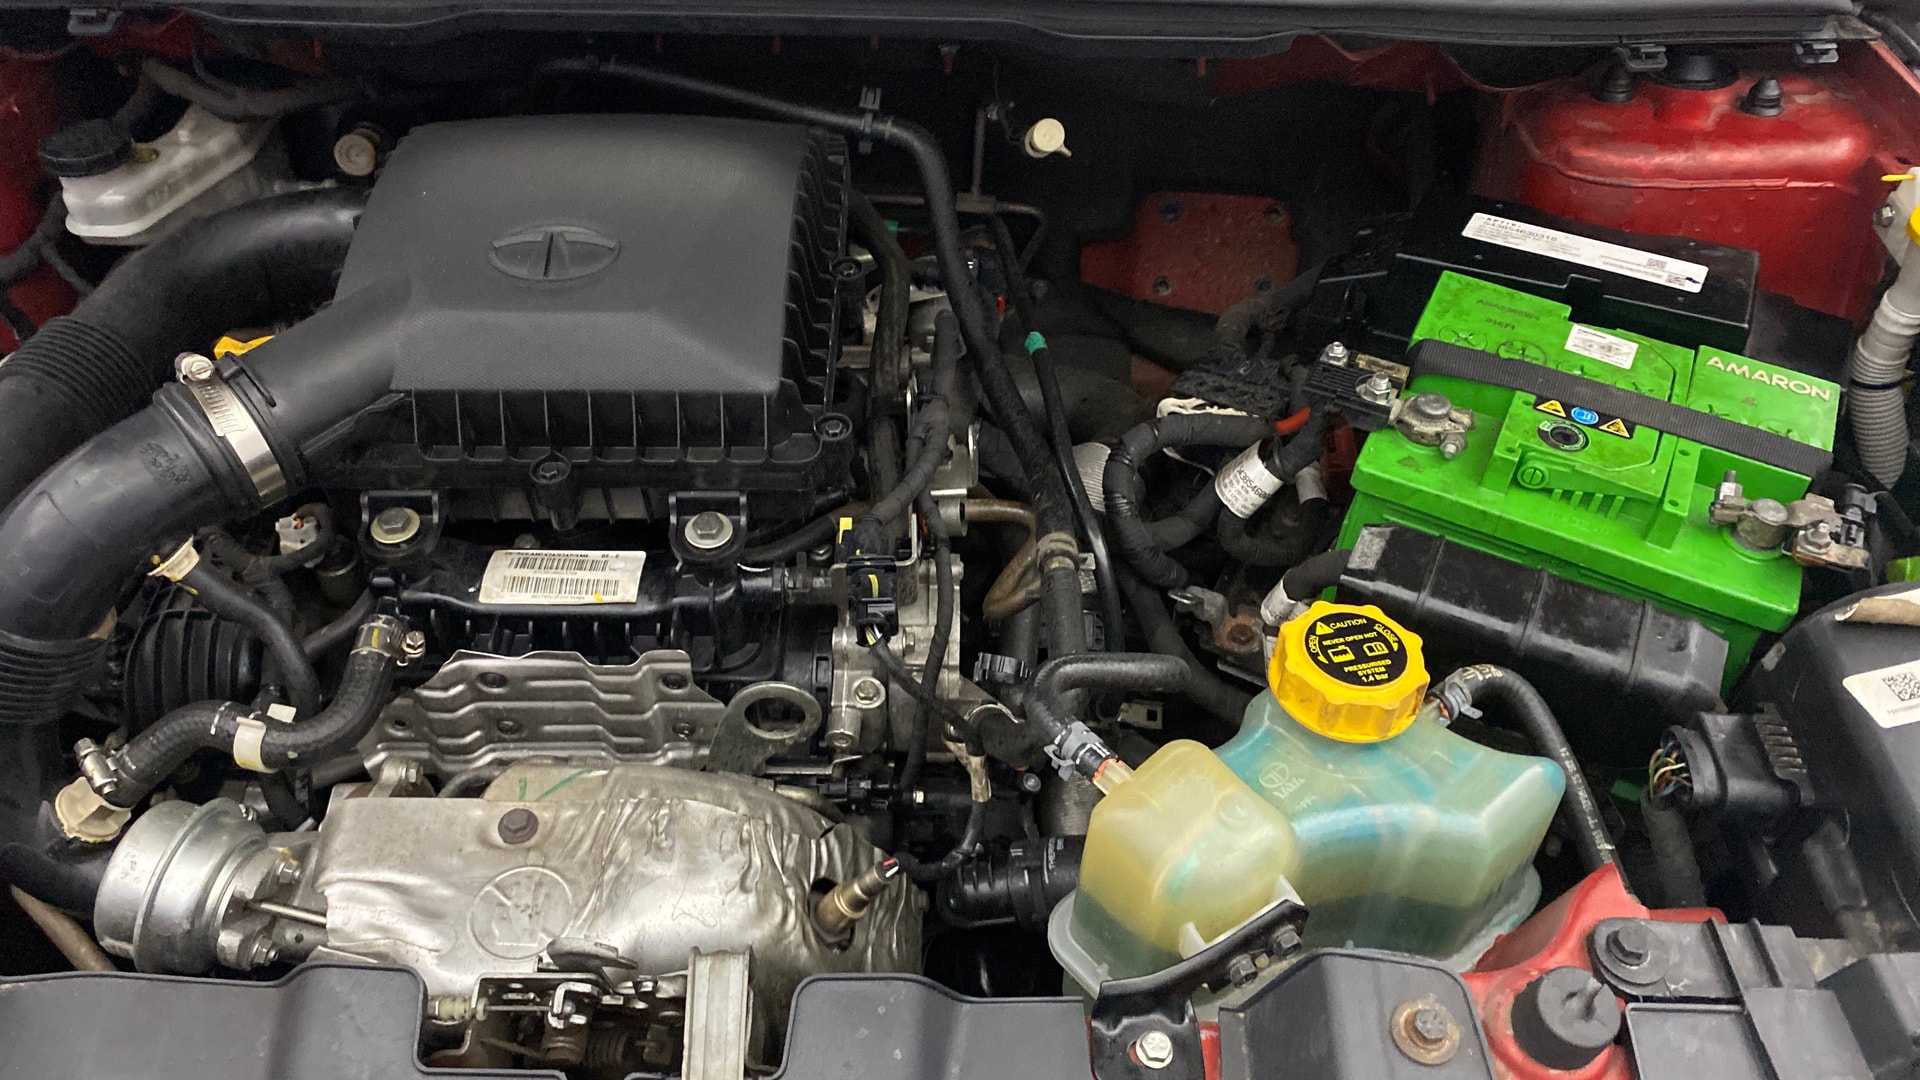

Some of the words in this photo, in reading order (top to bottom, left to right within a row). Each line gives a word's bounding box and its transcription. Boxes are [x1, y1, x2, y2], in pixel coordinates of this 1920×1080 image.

[1706, 356, 1831, 402] AMARON
[1330, 618, 1367, 629] CAUTION
[1322, 637, 1345, 646] NEVER
[1345, 634, 1363, 643] OPEN
[1363, 631, 1378, 640] HOT
[1375, 623, 1399, 642] CLOSE
[1308, 634, 1318, 653] OPEN
[1344, 659, 1391, 672] PRESSURISED
[1357, 666, 1386, 677] SYSTEM
[1361, 675, 1375, 683] 1.4
[1374, 673, 1389, 681] bar
